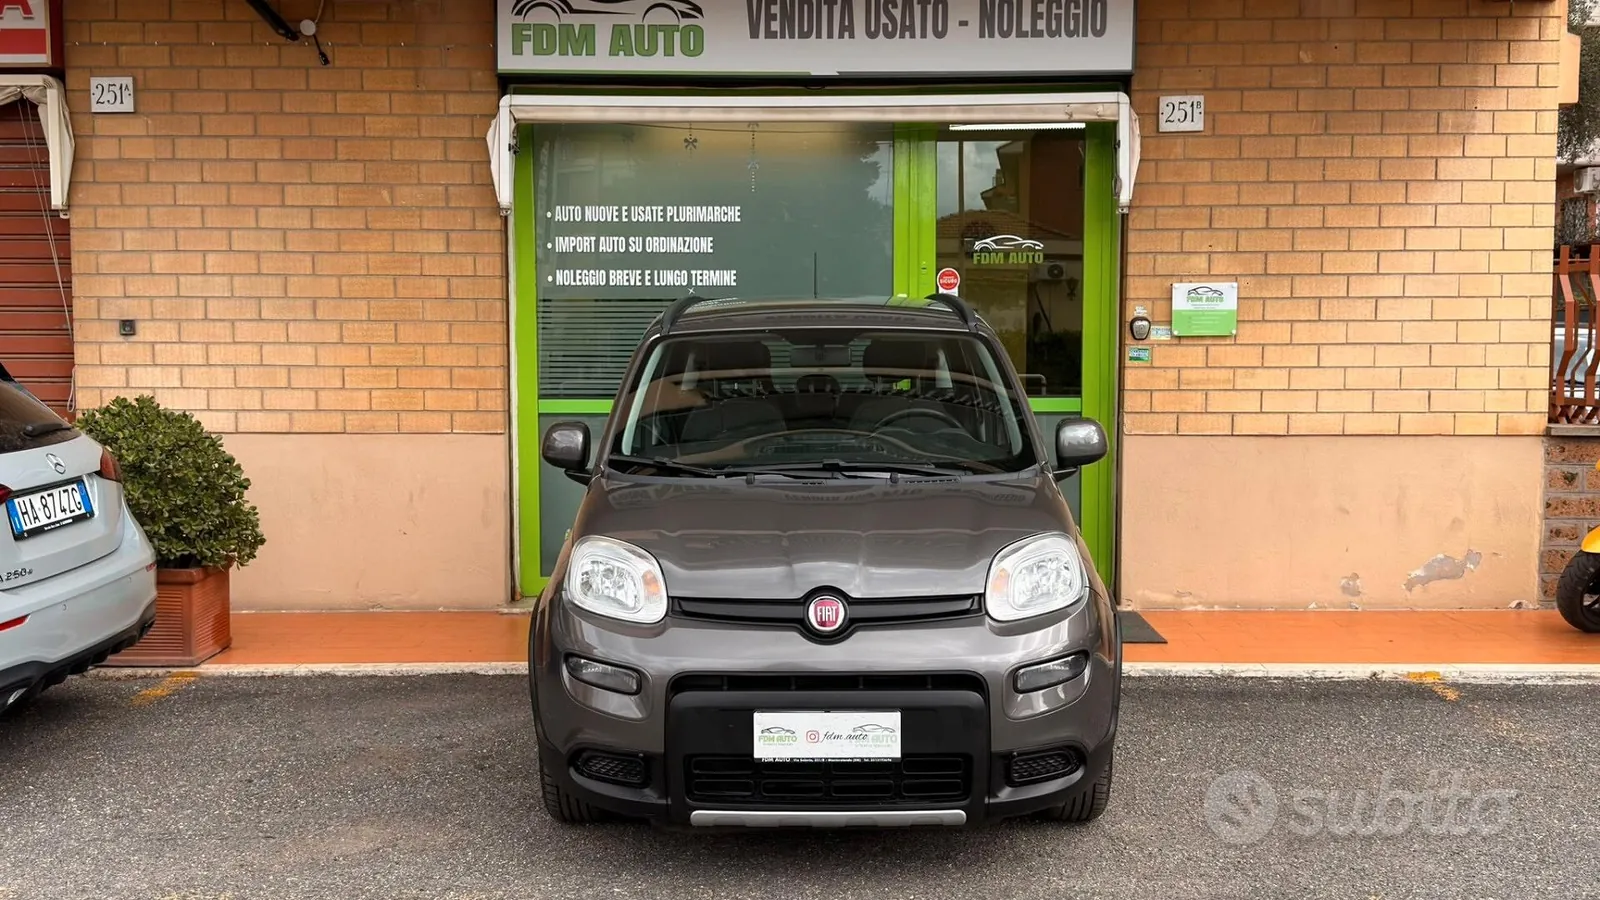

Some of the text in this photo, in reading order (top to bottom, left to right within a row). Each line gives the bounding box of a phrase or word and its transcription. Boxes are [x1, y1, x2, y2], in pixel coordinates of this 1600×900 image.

[746, 0, 855, 39] VENDITA
[864, 0, 949, 39] USATO
[979, 0, 1107, 38] NOLEGGIO
[511, 23, 705, 57] FDM AUTO
[555, 205, 741, 222] AUTO NUOVE E USATE PLURIMARCHE
[555, 236, 714, 253] IMPORT AUTO SU ORDINAZIONE
[973, 251, 1044, 264] FDM AUTO
[555, 269, 737, 286] NOLEGGIO BREVE E LUNGO TERMINE
[17, 498, 41, 527] HA
[816, 605, 838, 622] FIAT
[758, 735, 798, 743] FDM AUTO
[871, 734, 897, 744] AUTO
